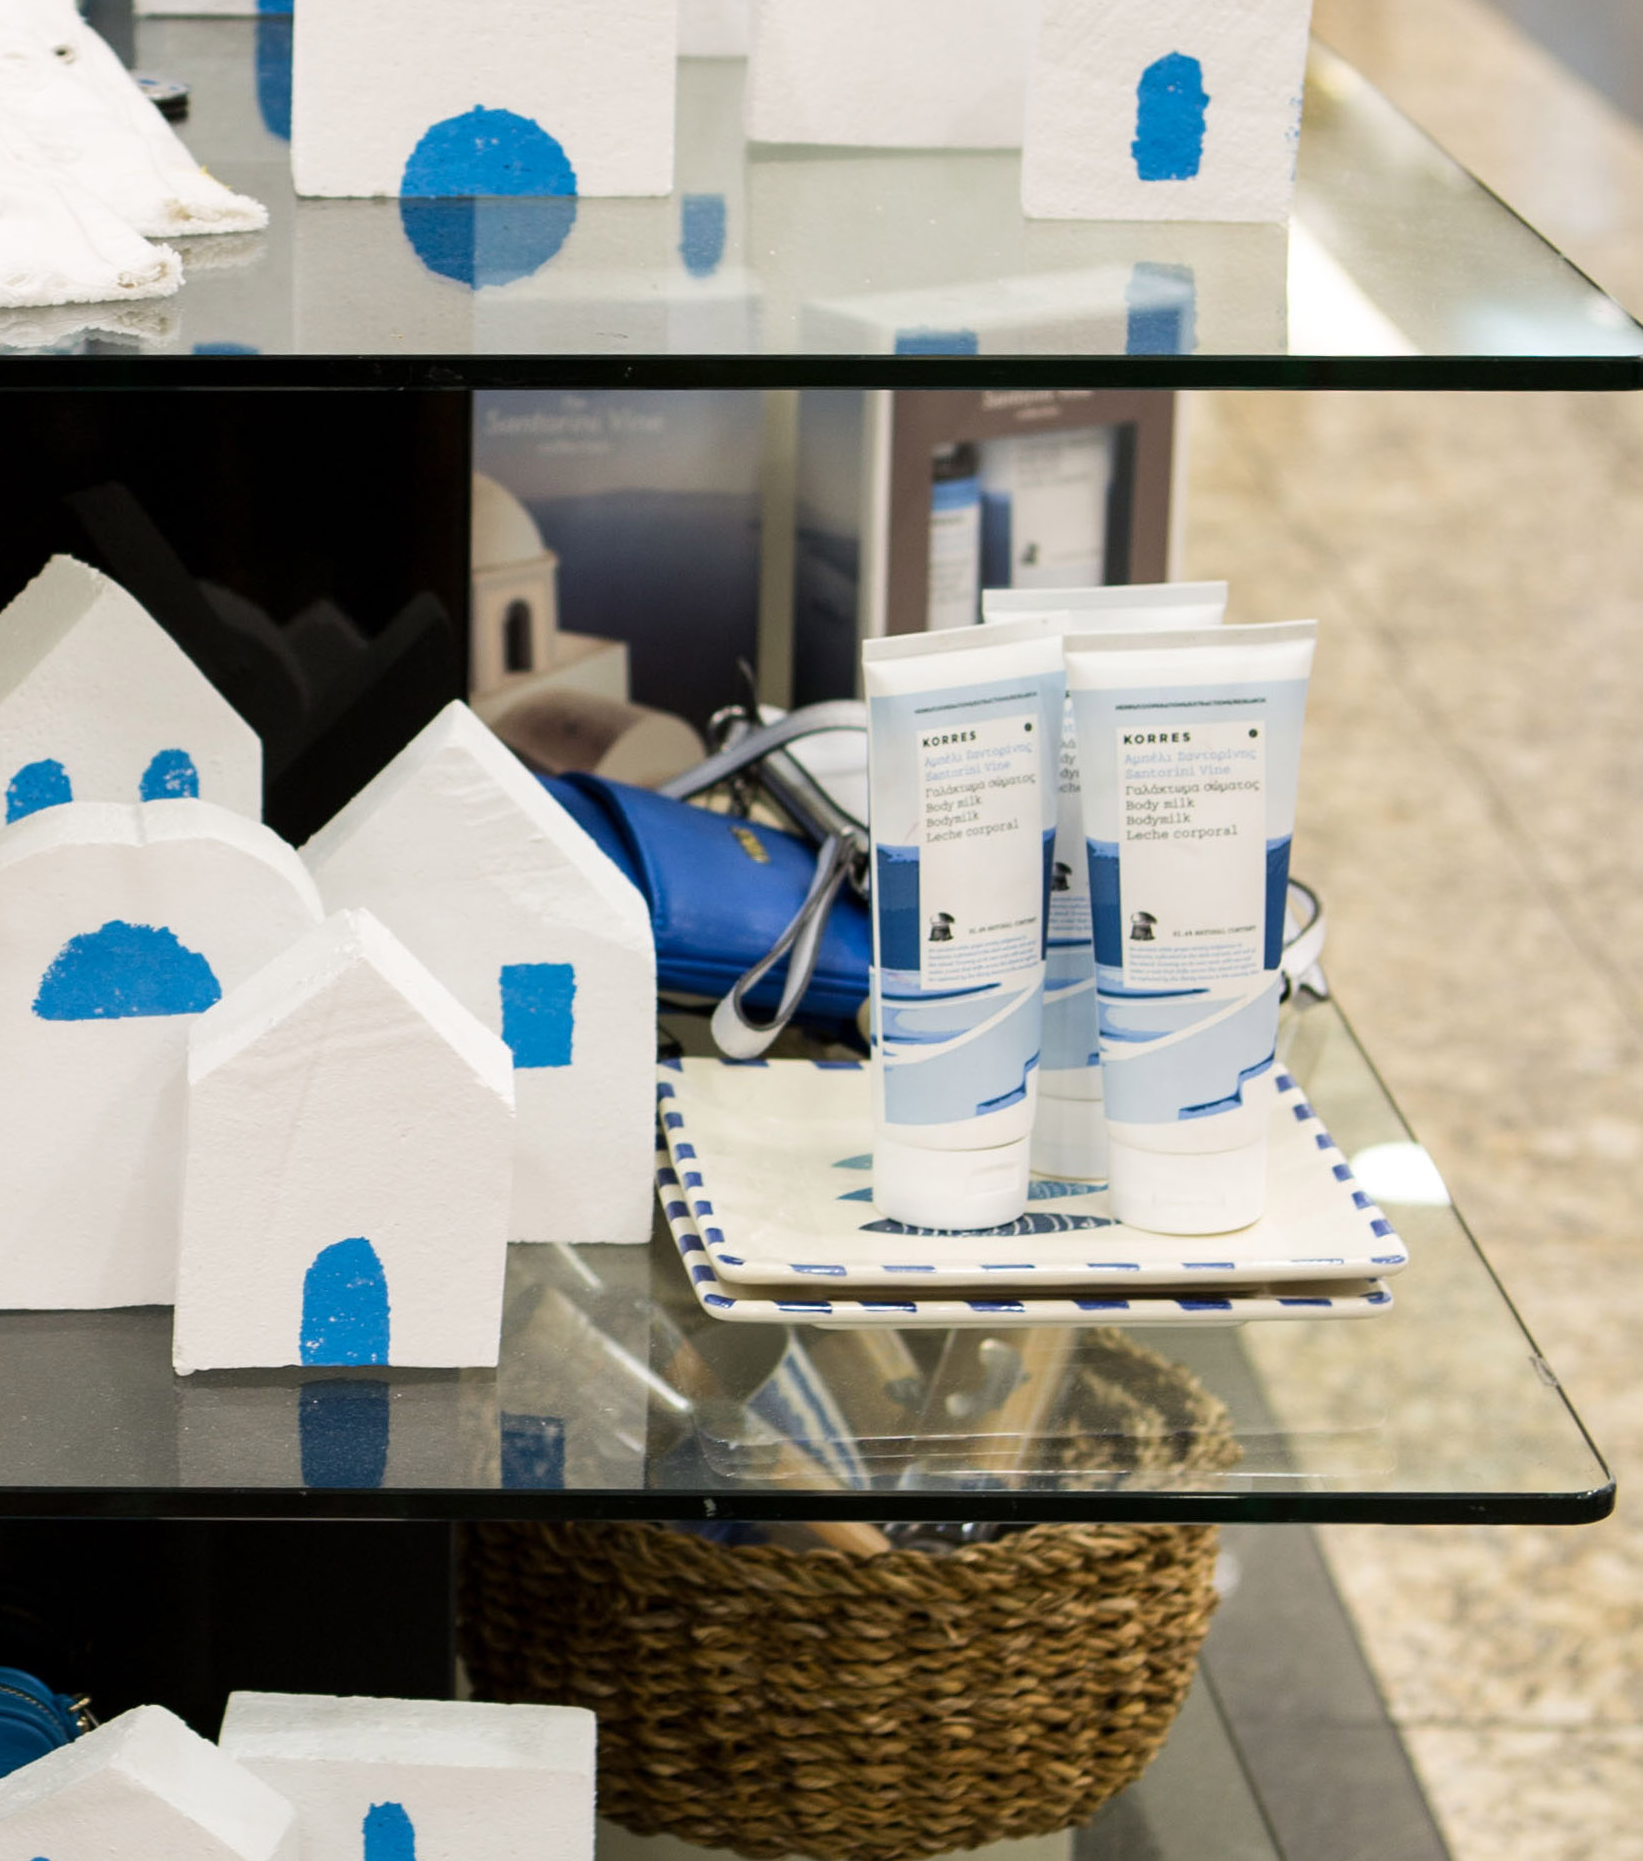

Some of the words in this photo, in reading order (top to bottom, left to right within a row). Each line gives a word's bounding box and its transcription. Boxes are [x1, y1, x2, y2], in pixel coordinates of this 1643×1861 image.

[922, 730, 977, 748] KORRES
[1123, 731, 1191, 745] KORRES
[925, 765, 982, 782] Santorini
[984, 760, 1011, 773] Vine
[1124, 765, 1196, 779] Santorini
[1199, 764, 1231, 776] Vine
[925, 801, 954, 813] Body
[957, 795, 982, 809] milk
[1125, 800, 1159, 812] Body
[1164, 797, 1195, 810] milk
[926, 810, 979, 828] Bodymilk
[1126, 813, 1191, 827] Bodymilk
[926, 829, 963, 843] Leche
[966, 818, 1019, 836] corporal
[1126, 830, 1169, 841] Leche
[1173, 824, 1238, 839] corporal
